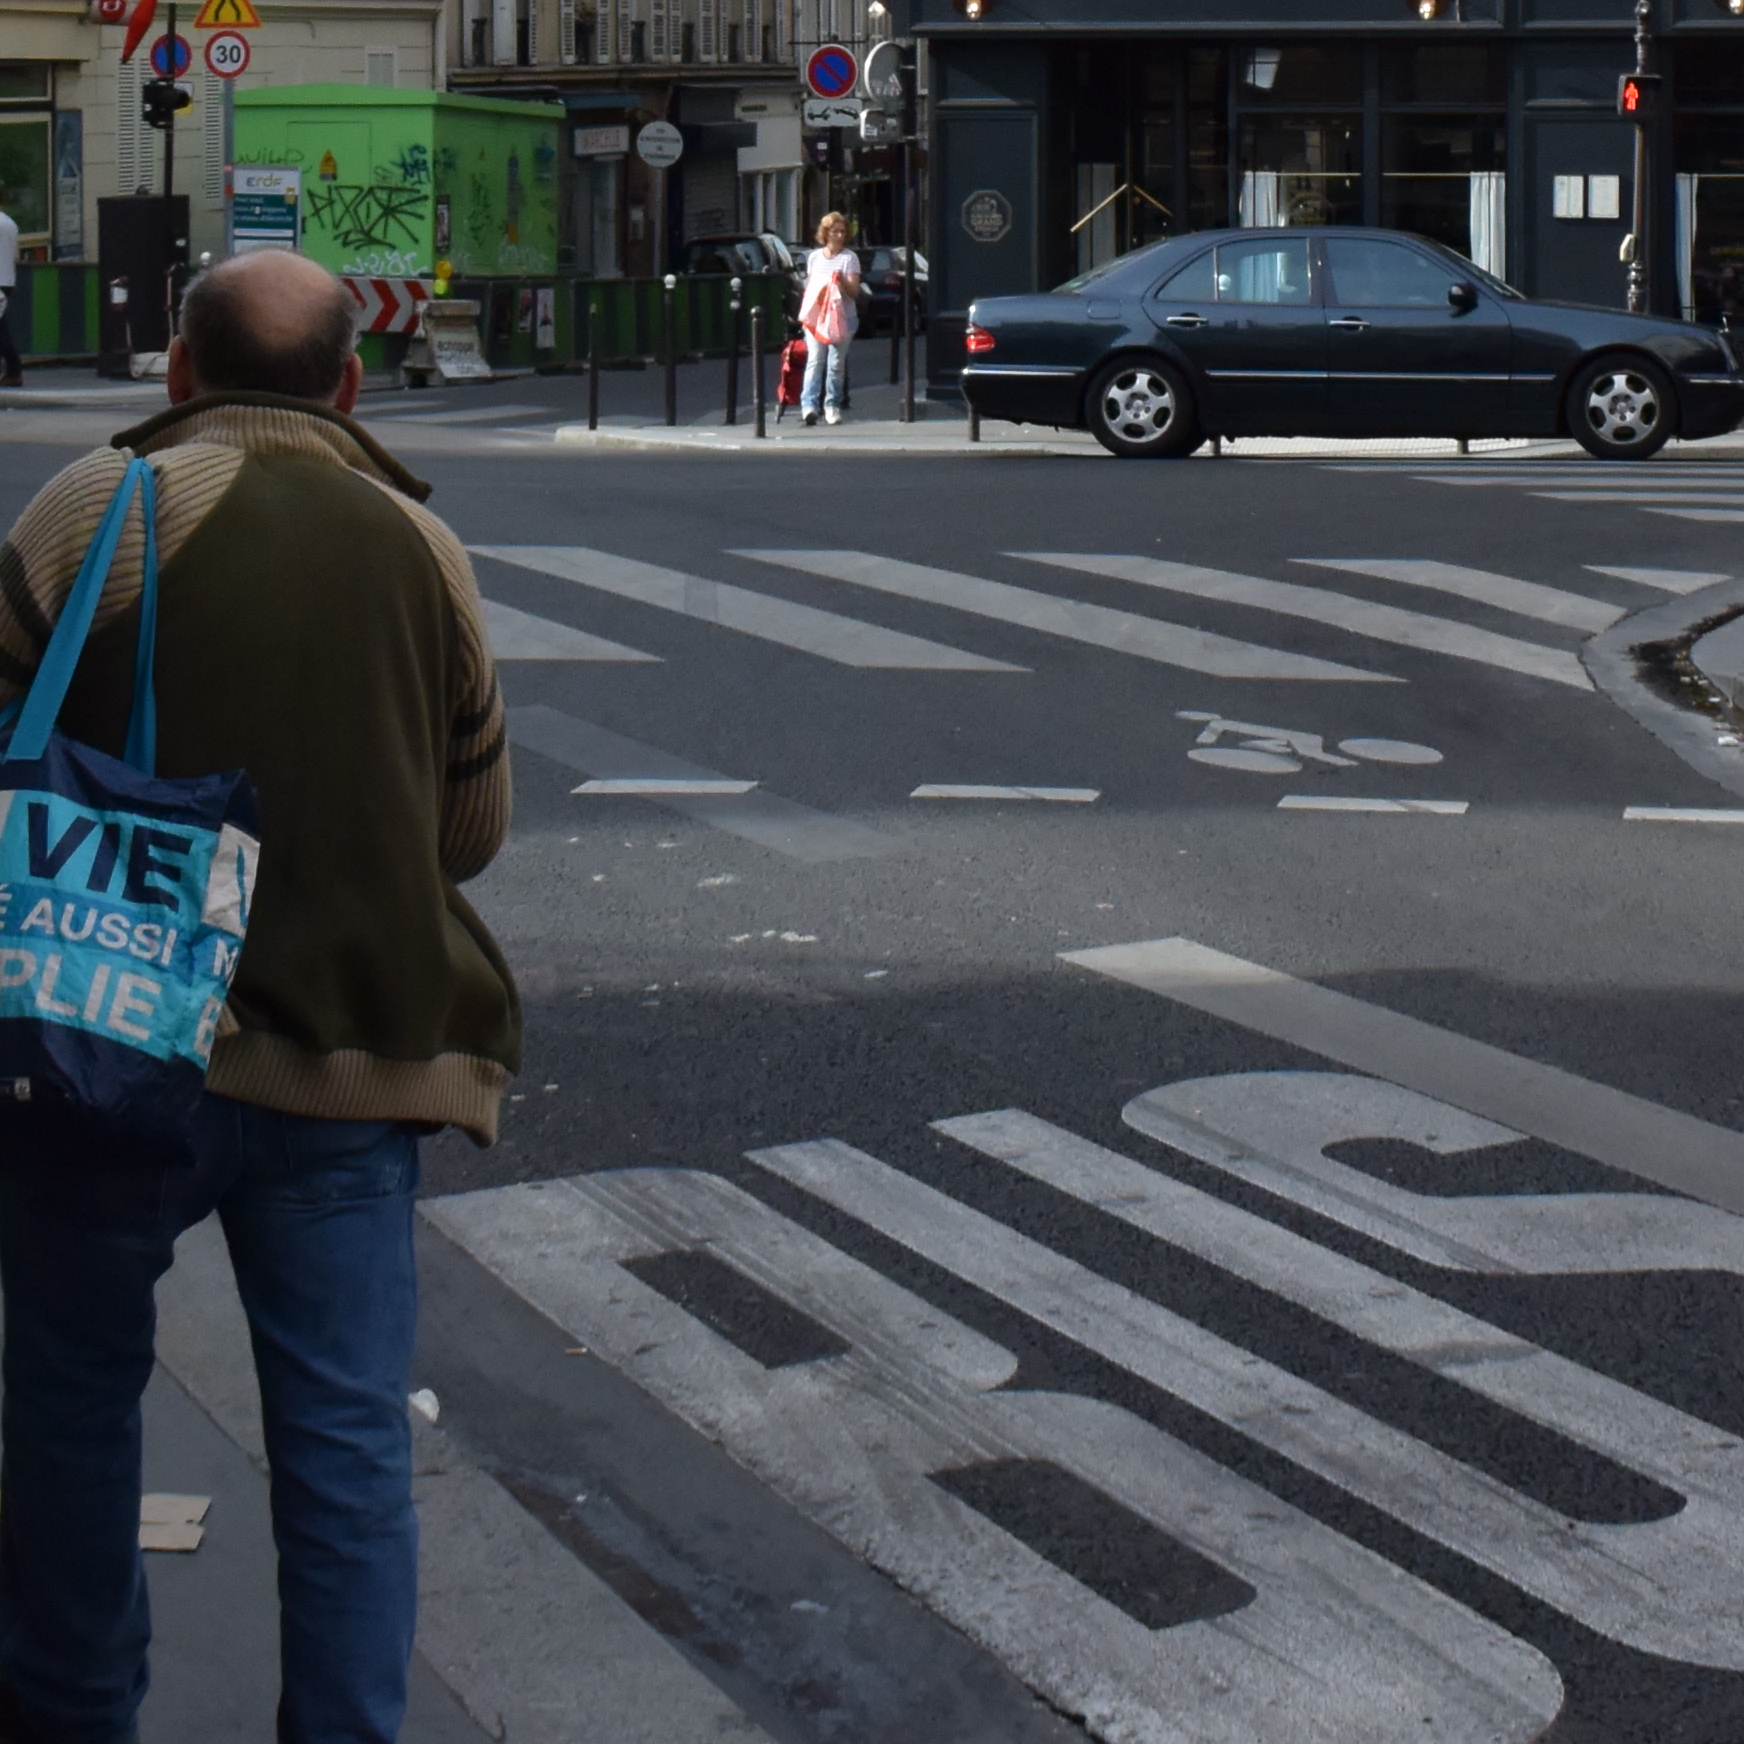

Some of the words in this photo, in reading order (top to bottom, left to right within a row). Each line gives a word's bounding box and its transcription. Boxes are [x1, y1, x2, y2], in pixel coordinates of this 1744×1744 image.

[215, 44, 241, 64] 30
[26, 801, 193, 912] VIE
[20, 896, 177, 968] AUSSI
